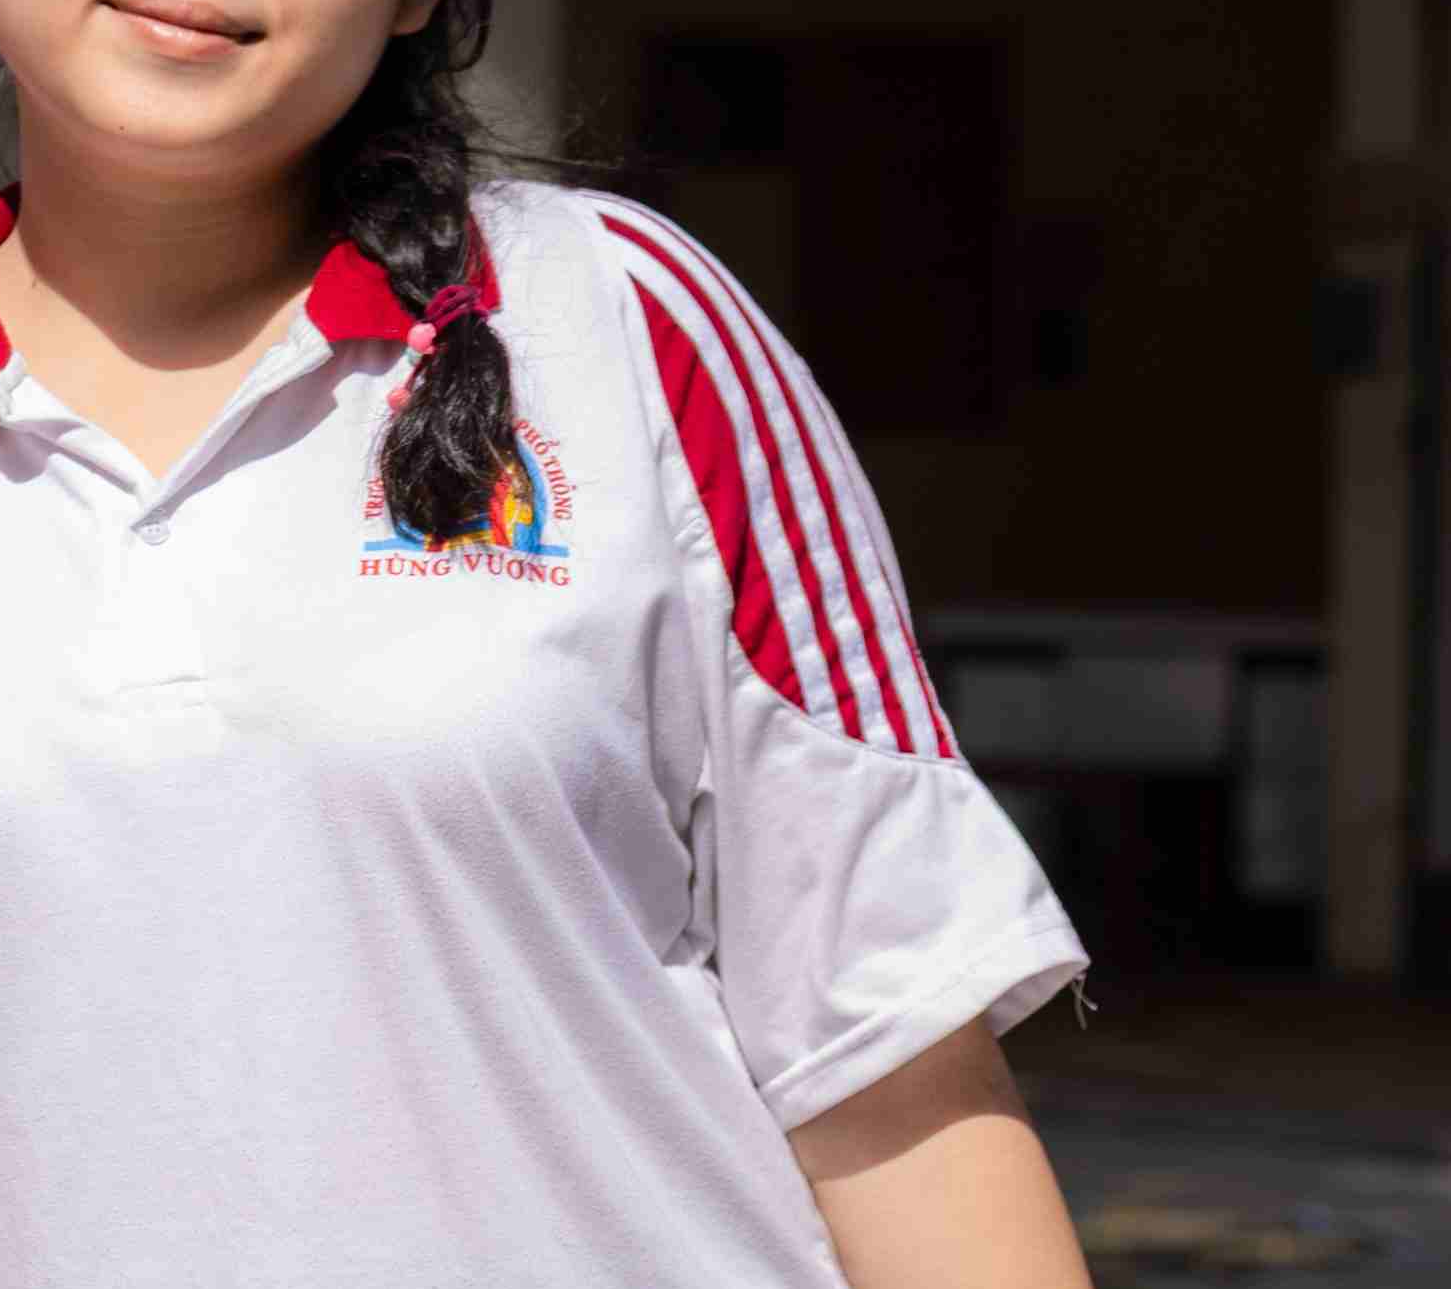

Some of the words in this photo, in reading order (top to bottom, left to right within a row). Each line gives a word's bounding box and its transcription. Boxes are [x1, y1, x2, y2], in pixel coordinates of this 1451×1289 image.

[543, 456, 577, 521] THÔNG
[359, 553, 452, 577] HÙNG
[463, 553, 571, 587] VƯƠNG
